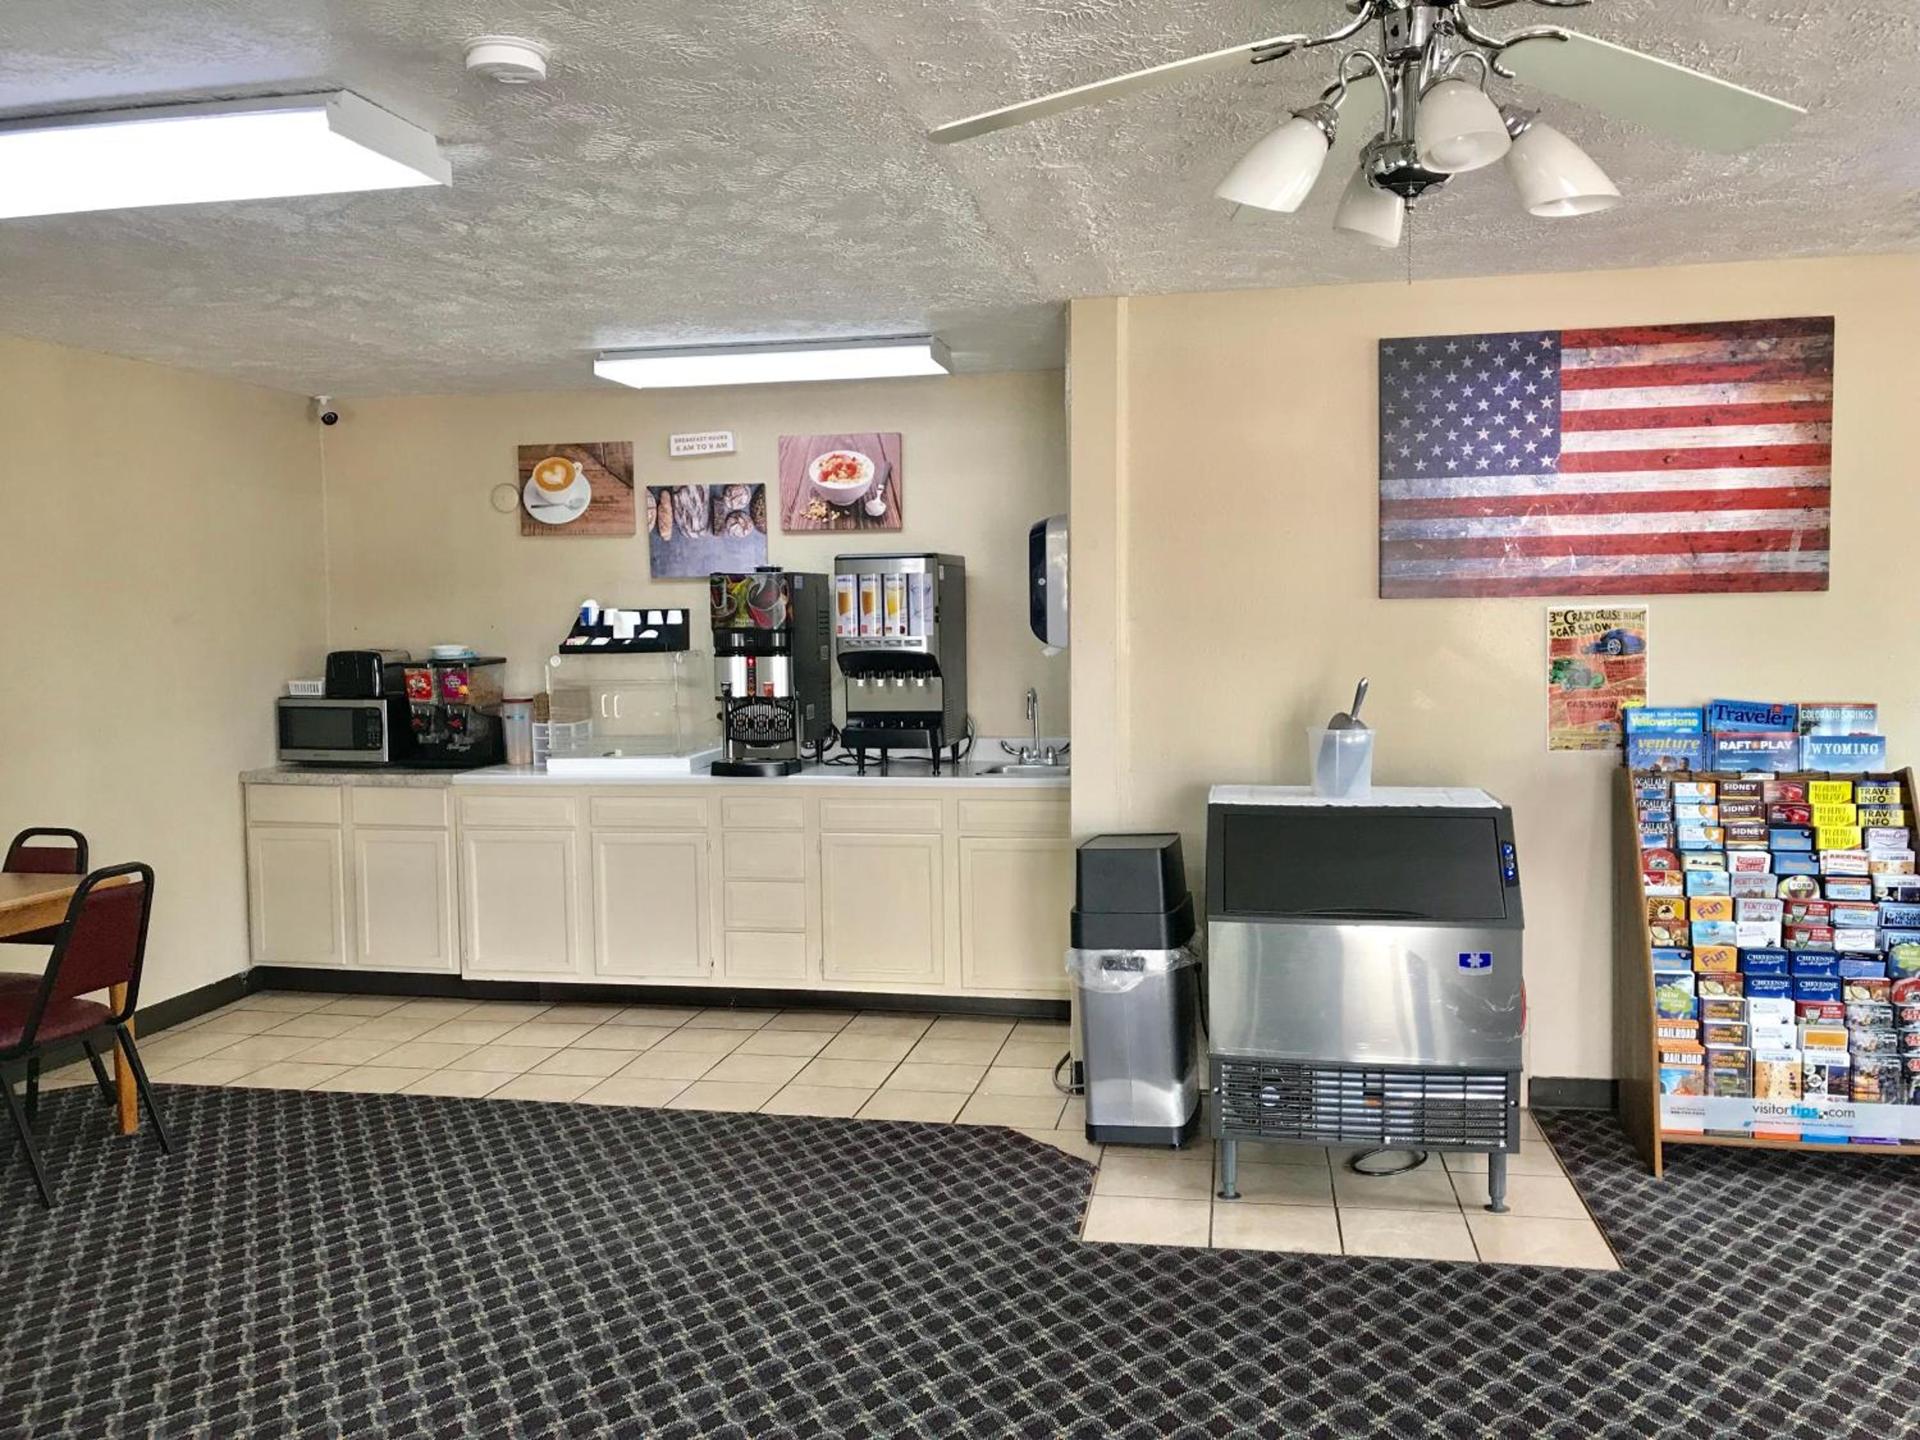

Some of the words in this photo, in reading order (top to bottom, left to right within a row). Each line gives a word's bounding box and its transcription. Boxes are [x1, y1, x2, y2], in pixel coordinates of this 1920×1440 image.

[1564, 610, 1595, 625] CRAZY
[1556, 625, 1578, 637] CAR
[1578, 622, 1612, 635] SHOW
[1713, 704, 1793, 726] Traveler
[1631, 715, 1699, 727] Yellowstone
[1719, 740, 1751, 750] RAFT
[1760, 740, 1793, 750] PLAY
[1811, 743, 1879, 755] WYOMING
[1723, 783, 1757, 791] SIDNEY
[1860, 787, 1896, 796] TRAVEL
[1723, 805, 1756, 813] SIDNEY
[1863, 809, 1897, 818] TRAVEL
[1731, 828, 1765, 836] SIDNEY
[1697, 902, 1723, 919] Fun
[1700, 950, 1728, 967] Fun
[1747, 953, 1785, 962] CHEYENNE
[1796, 955, 1835, 963] CHEYENNE
[1751, 979, 1790, 988] CHEYENNE
[1799, 980, 1838, 989] CHEYENNE
